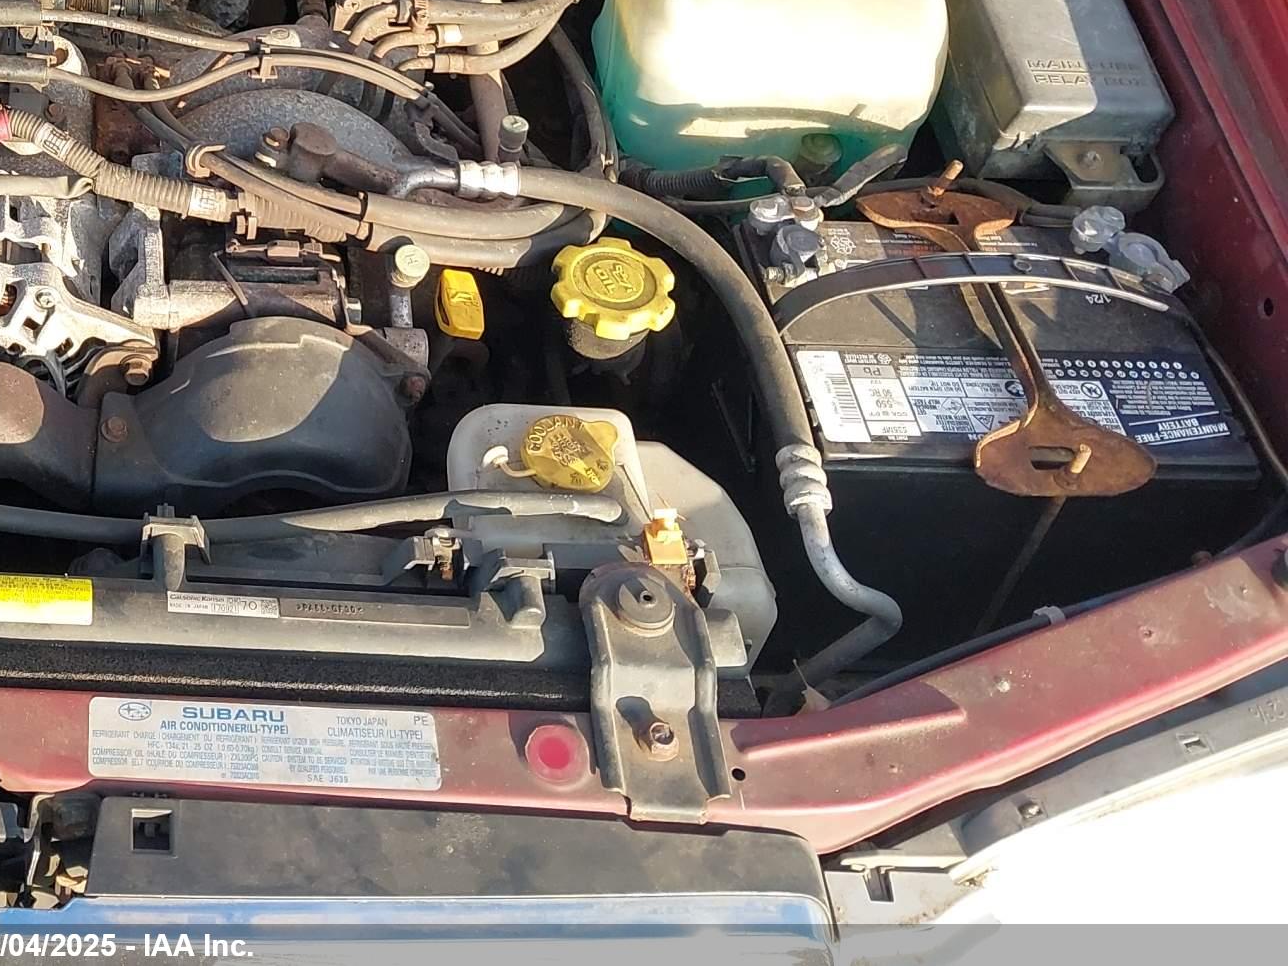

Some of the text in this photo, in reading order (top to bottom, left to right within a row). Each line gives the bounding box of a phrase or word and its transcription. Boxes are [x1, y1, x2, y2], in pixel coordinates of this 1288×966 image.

[1026, 58, 1085, 71] MAIN
[1033, 73, 1094, 85] RELAY
[592, 265, 617, 295] OIL
[863, 367, 881, 376] Pb
[876, 400, 893, 408] 550
[1157, 418, 1199, 431] BATTERY
[527, 414, 586, 452] COOLANT
[1134, 422, 1229, 444] MAINTENANCE-FREE
[241, 600, 257, 611] 70
[182, 706, 285, 722] SUBARU
[336, 716, 388, 727] TOKYO JAPAN
[413, 715, 429, 726] PE
[160, 721, 176, 732] AIR
[327, 727, 384, 738] CLIMATISEUR
[307, 774, 349, 783] SAE J639
